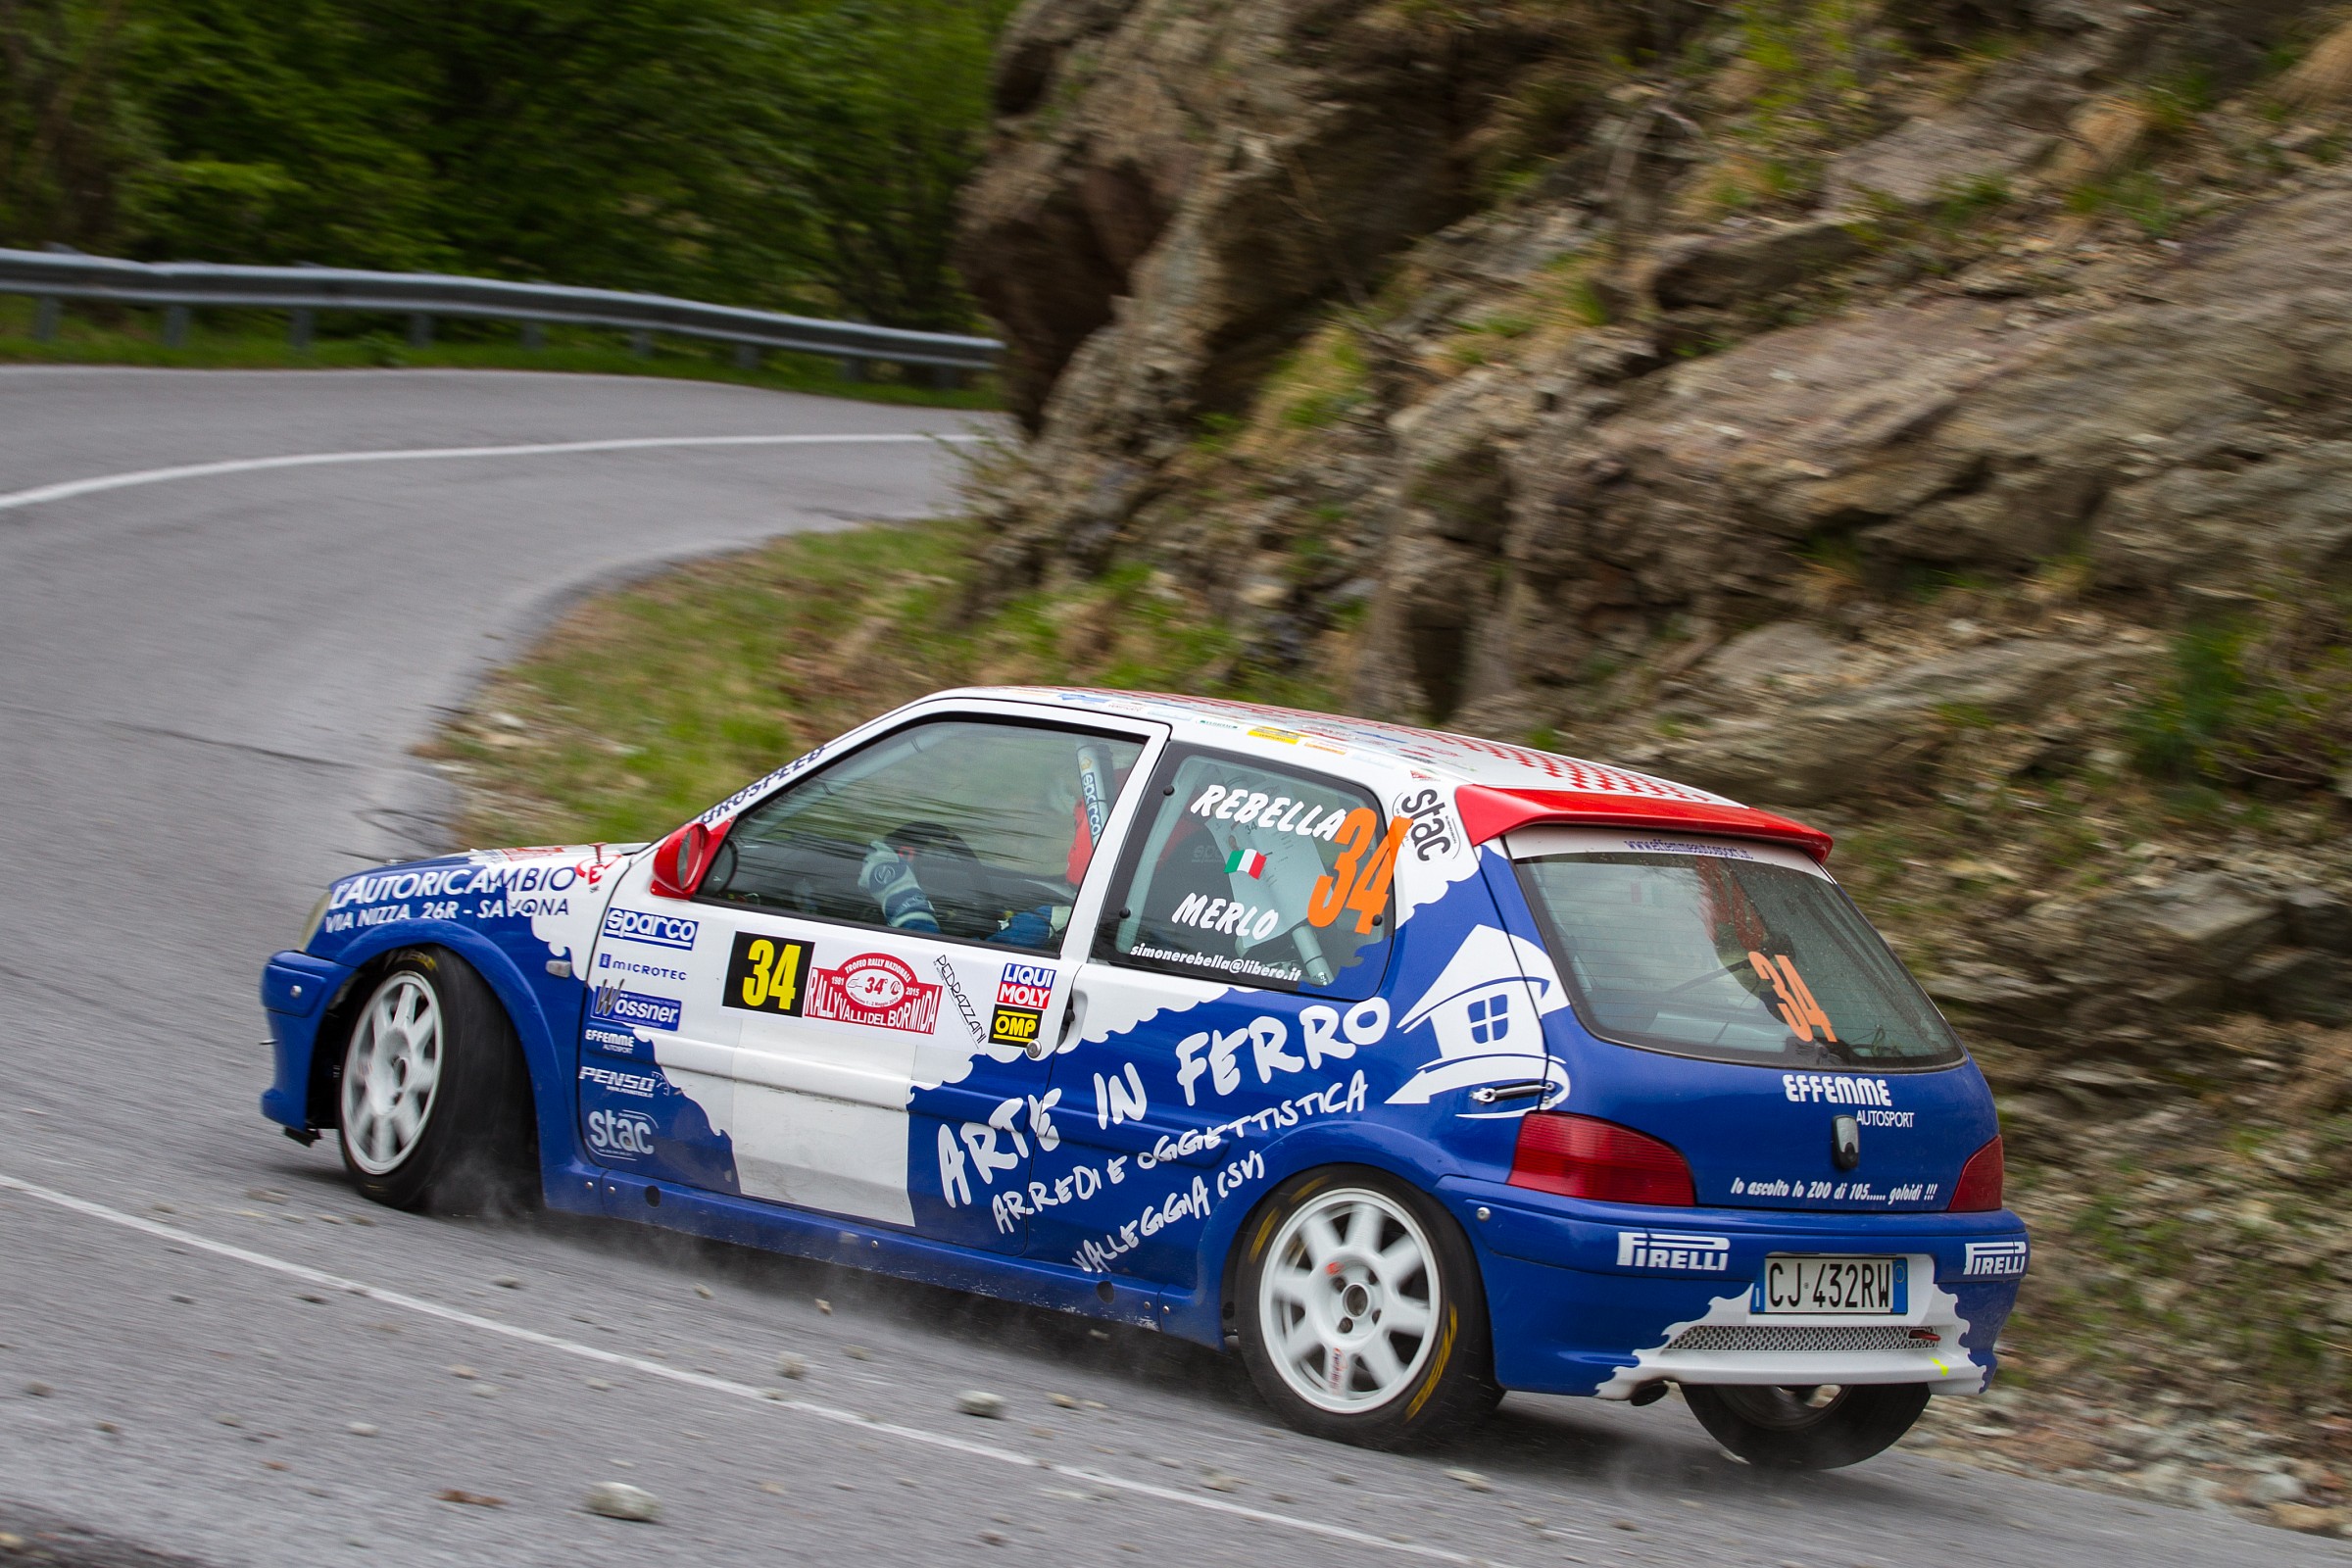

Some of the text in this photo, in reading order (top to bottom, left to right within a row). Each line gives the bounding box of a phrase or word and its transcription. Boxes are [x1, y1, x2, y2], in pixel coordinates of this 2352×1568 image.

[1081, 773, 1102, 836] sparco
[1191, 785, 1347, 841] REBELLA
[1401, 789, 1451, 861] stac
[1306, 807, 1415, 935] 34
[325, 912, 355, 934] VIA
[357, 904, 411, 927] NIZZA
[420, 901, 460, 919] 26R
[476, 899, 569, 919] SAVONA
[607, 909, 697, 942] sparco
[1172, 893, 1279, 941] MERLO
[742, 938, 802, 1010] 34
[845, 958, 867, 974] TROFEO
[867, 957, 885, 967] RALLY
[1004, 964, 1055, 988] LIQUI
[1130, 943, 1301, 982] simonerebella@libero.it
[594, 978, 680, 1024] Wössner
[805, 968, 940, 1034] RALLY VALLI DEL BORMIDA
[906, 986, 920, 997] 2015
[936, 955, 987, 1044] PEDRAZZANI
[999, 984, 1050, 1007] MOLY
[1747, 951, 1838, 1043] 34
[584, 1029, 635, 1048] EFFEMME
[995, 1015, 1037, 1037] OMP
[578, 1066, 656, 1092] PENSO
[1783, 1074, 1892, 1106] EFFEMME
[938, 997, 1391, 1208] ARTE IN FERRO
[1856, 1110, 1915, 1128] AUTOSPORT
[588, 1108, 656, 1154] stac
[992, 1069, 1368, 1234] ARREDI E OGGETTISTICA
[1072, 1150, 1265, 1273] VALLEGGIA (SV)
[1746, 1179, 1789, 1197] ascolto
[1834, 1182, 1848, 1200] di
[1887, 1184, 1923, 1205] goloidi
[1923, 1184, 1938, 1200] !!!
[1617, 1232, 1731, 1271] PIRELLI
[1963, 1242, 2027, 1275] PIRELLI
[1769, 1262, 1889, 1308] CJ 432RW
